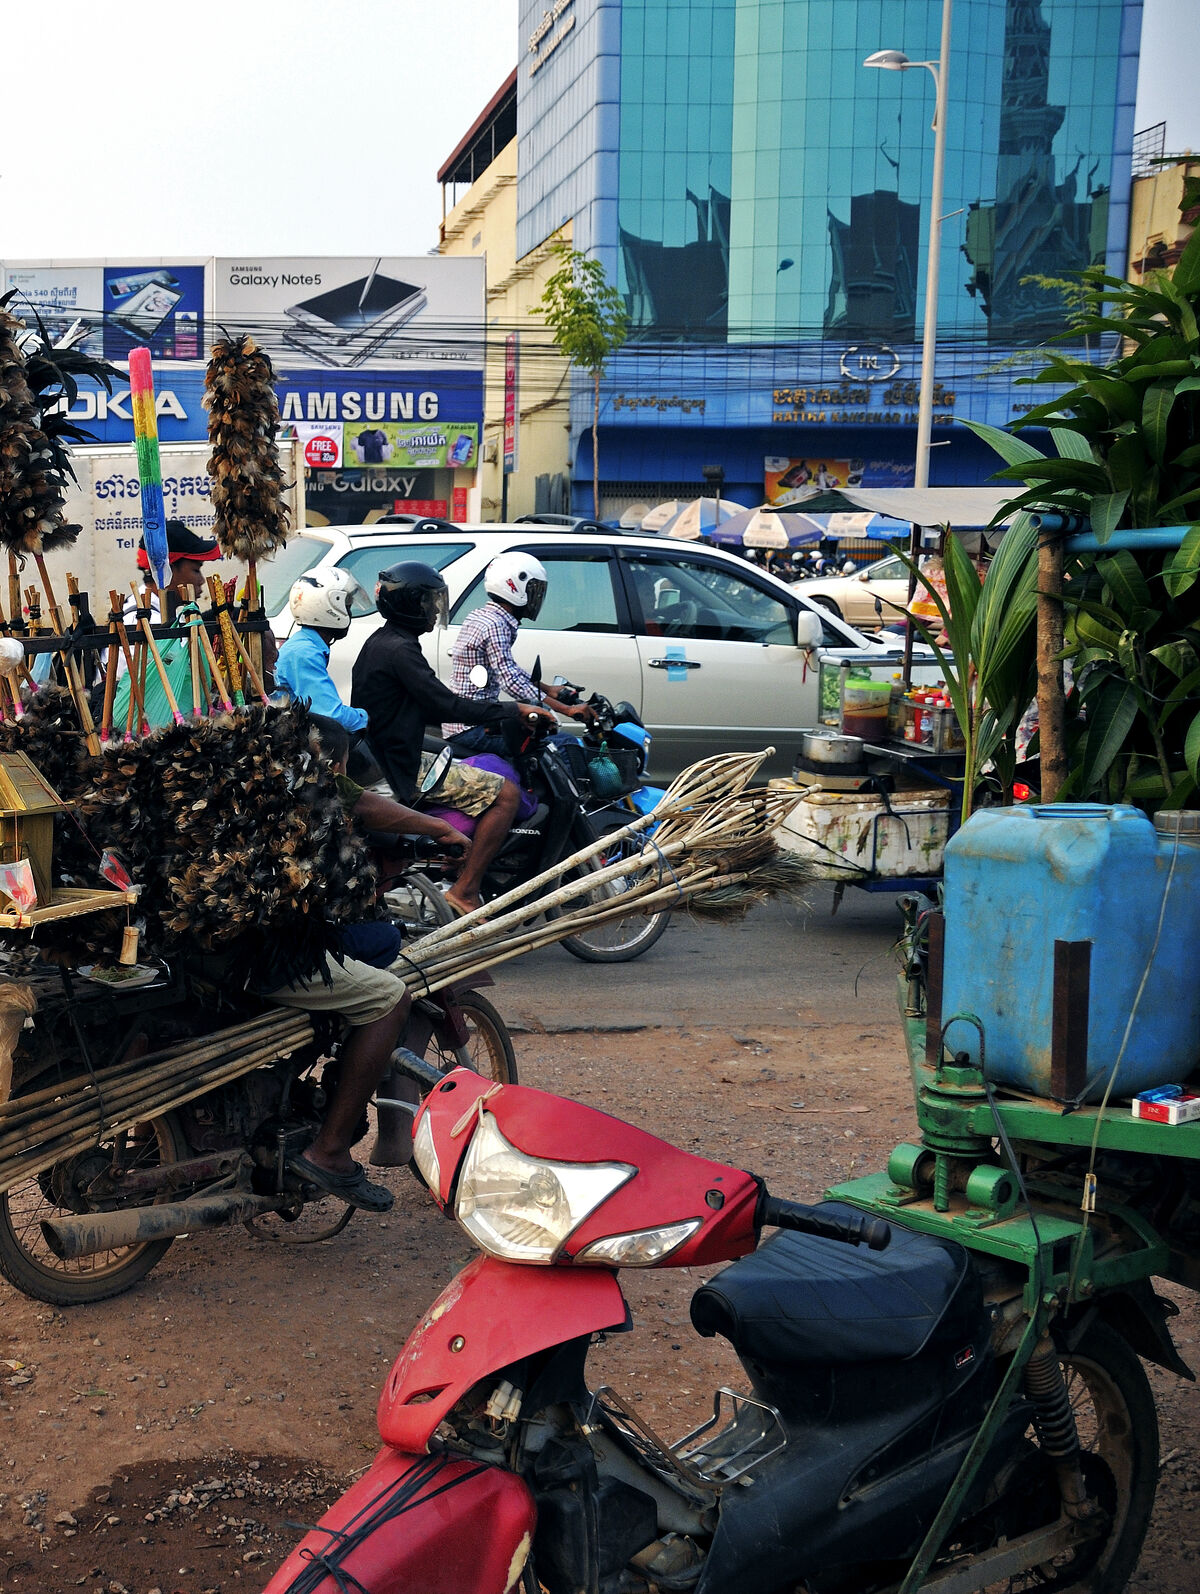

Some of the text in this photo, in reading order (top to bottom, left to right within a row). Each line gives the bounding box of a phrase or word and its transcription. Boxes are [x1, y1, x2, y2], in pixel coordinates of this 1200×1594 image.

[230, 274, 322, 288] Galaxy Note5
[281, 391, 439, 421] AMSUNG
[311, 440, 332, 451] FREE
[332, 472, 416, 498] Galaxy
[116, 538, 135, 549] Tel
[508, 828, 541, 836] HONDA
